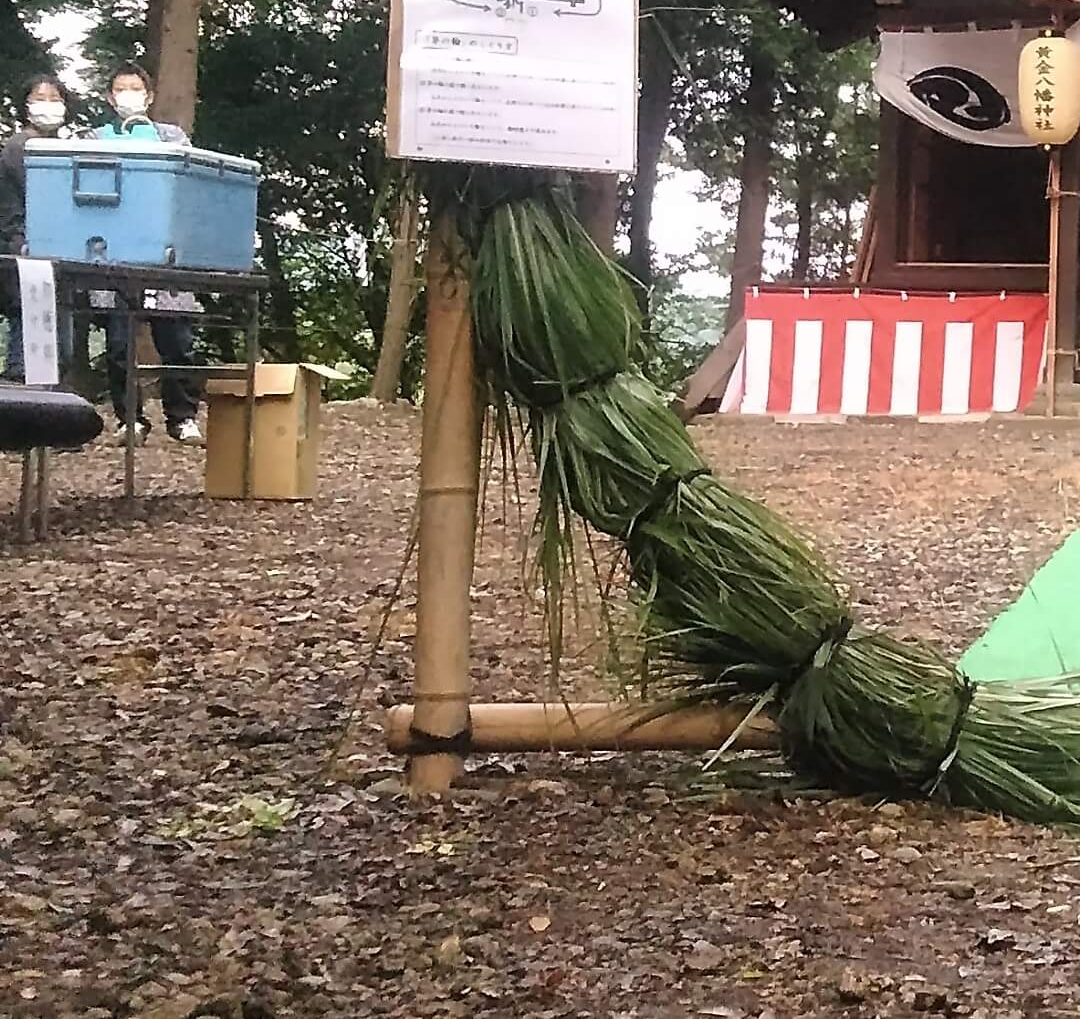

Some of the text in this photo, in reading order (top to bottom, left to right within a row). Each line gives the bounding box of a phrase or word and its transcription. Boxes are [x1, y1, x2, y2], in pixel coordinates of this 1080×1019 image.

[1034, 46, 1055, 131] 黄金八幡神社
